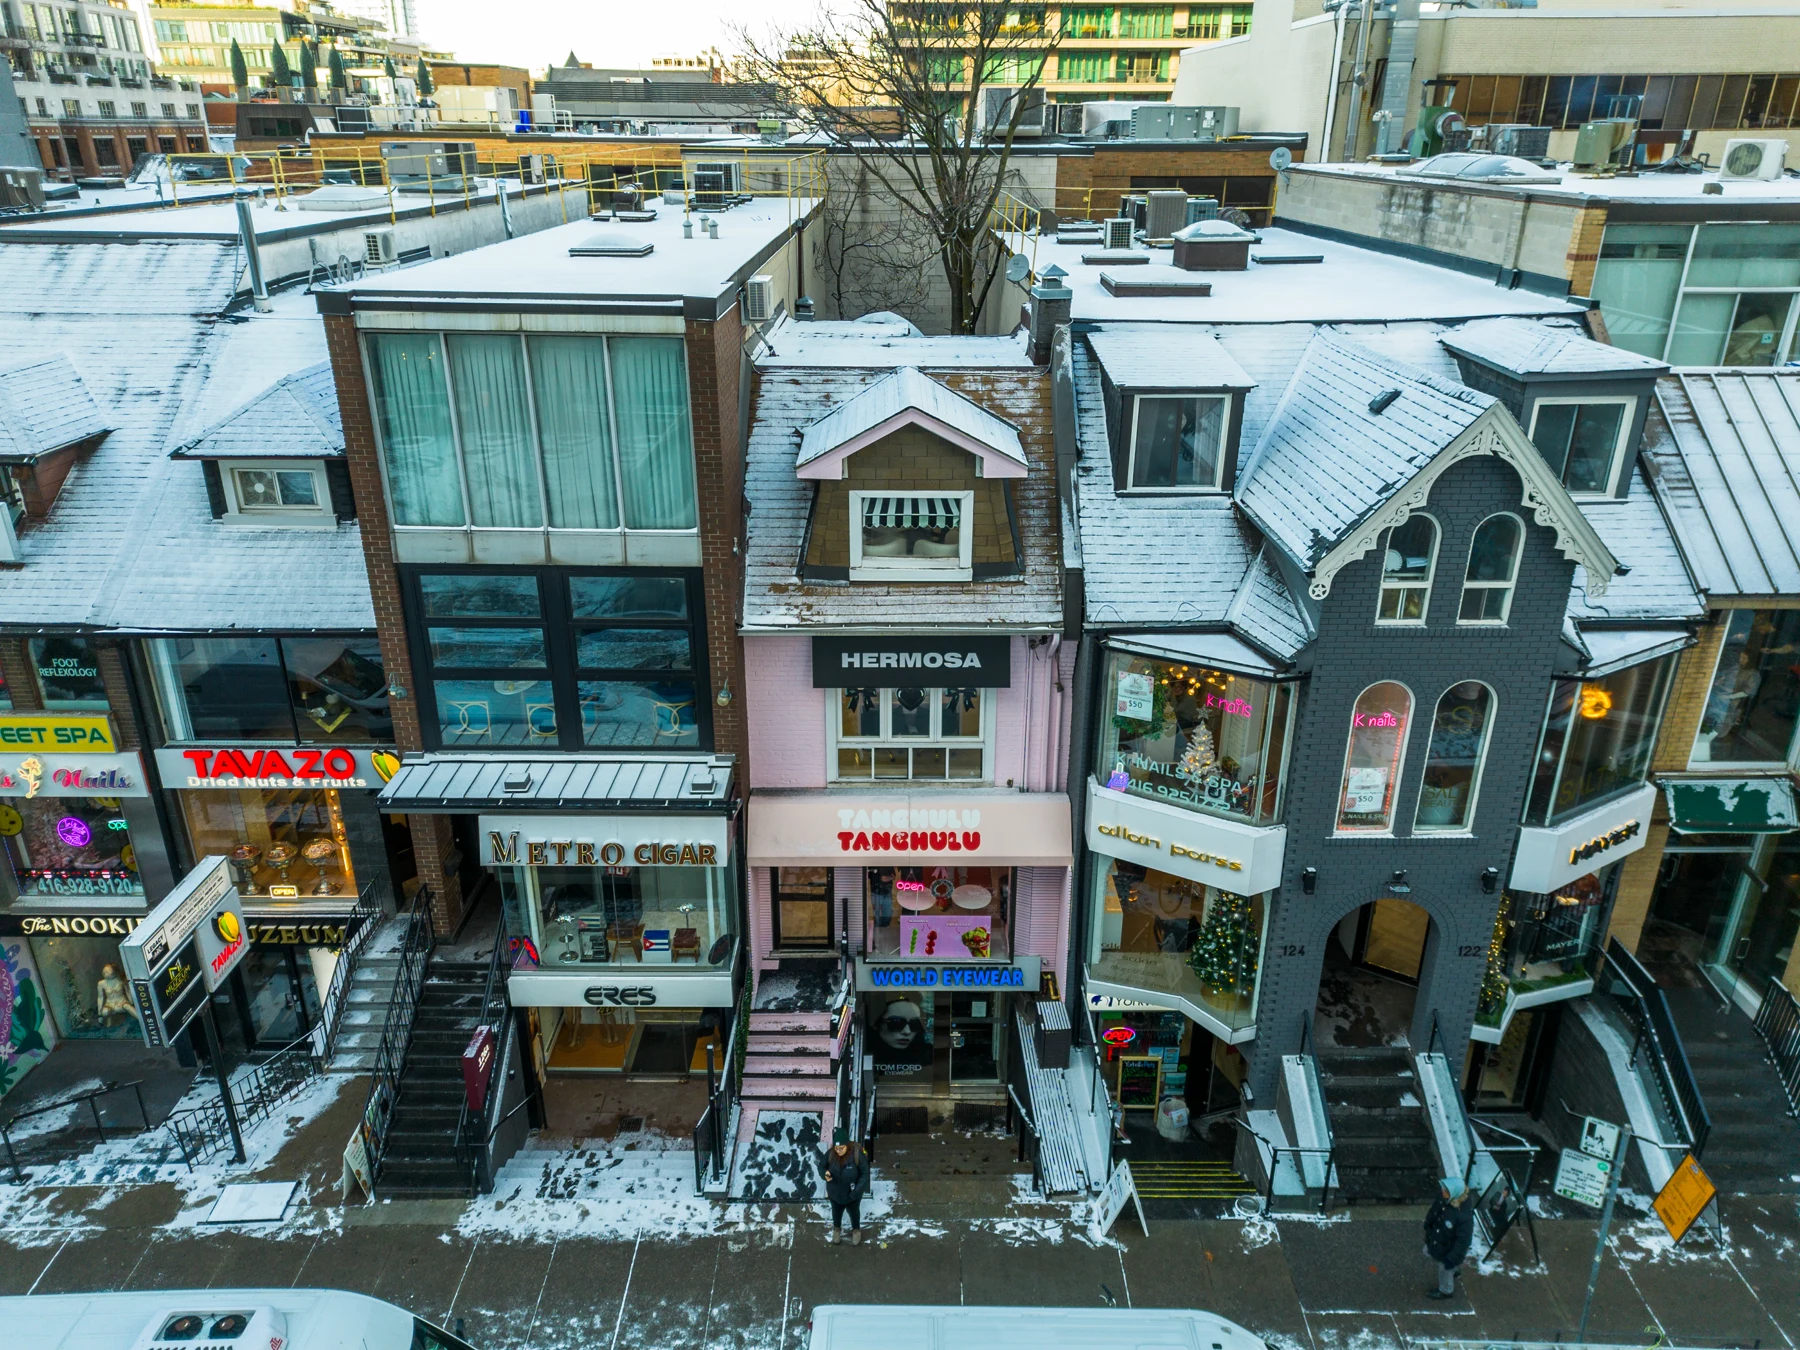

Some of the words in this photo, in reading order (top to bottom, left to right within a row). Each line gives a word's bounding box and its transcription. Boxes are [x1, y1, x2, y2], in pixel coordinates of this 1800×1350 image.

[52, 658, 79, 668] FOOT
[841, 652, 982, 668] HERMOSA
[39, 668, 97, 677] REFLEXOLOGY
[1128, 699, 1143, 708] $50
[1354, 714, 1365, 727] K
[1368, 712, 1397, 727] nails
[0, 727, 47, 743] EET
[53, 727, 108, 743] SPA
[183, 747, 357, 780] TAVAZO
[52, 768, 131, 788] Nails
[187, 776, 238, 787] Dried
[243, 776, 287, 787] Nuts
[292, 776, 305, 787] &
[310, 776, 367, 787] Fruits
[1135, 753, 1186, 780] NAILS
[1208, 775, 1243, 795] SPA
[1357, 795, 1374, 803] $50
[837, 808, 980, 829] TANGHULU
[488, 829, 625, 866] METRO
[633, 842, 717, 866] CIGAR
[837, 831, 980, 851] TANGHULU
[38, 878, 133, 895] 416-928-9120
[273, 888, 295, 896] OPEN
[22, 917, 51, 935] The
[248, 925, 348, 944] UZEUM
[1282, 945, 1305, 957] 124
[1457, 945, 1482, 957] 122
[872, 968, 939, 986] WORLD
[943, 968, 1024, 986] EYEWEAR
[583, 985, 656, 1006] ERES
[1105, 1030, 1133, 1041] OPEN
